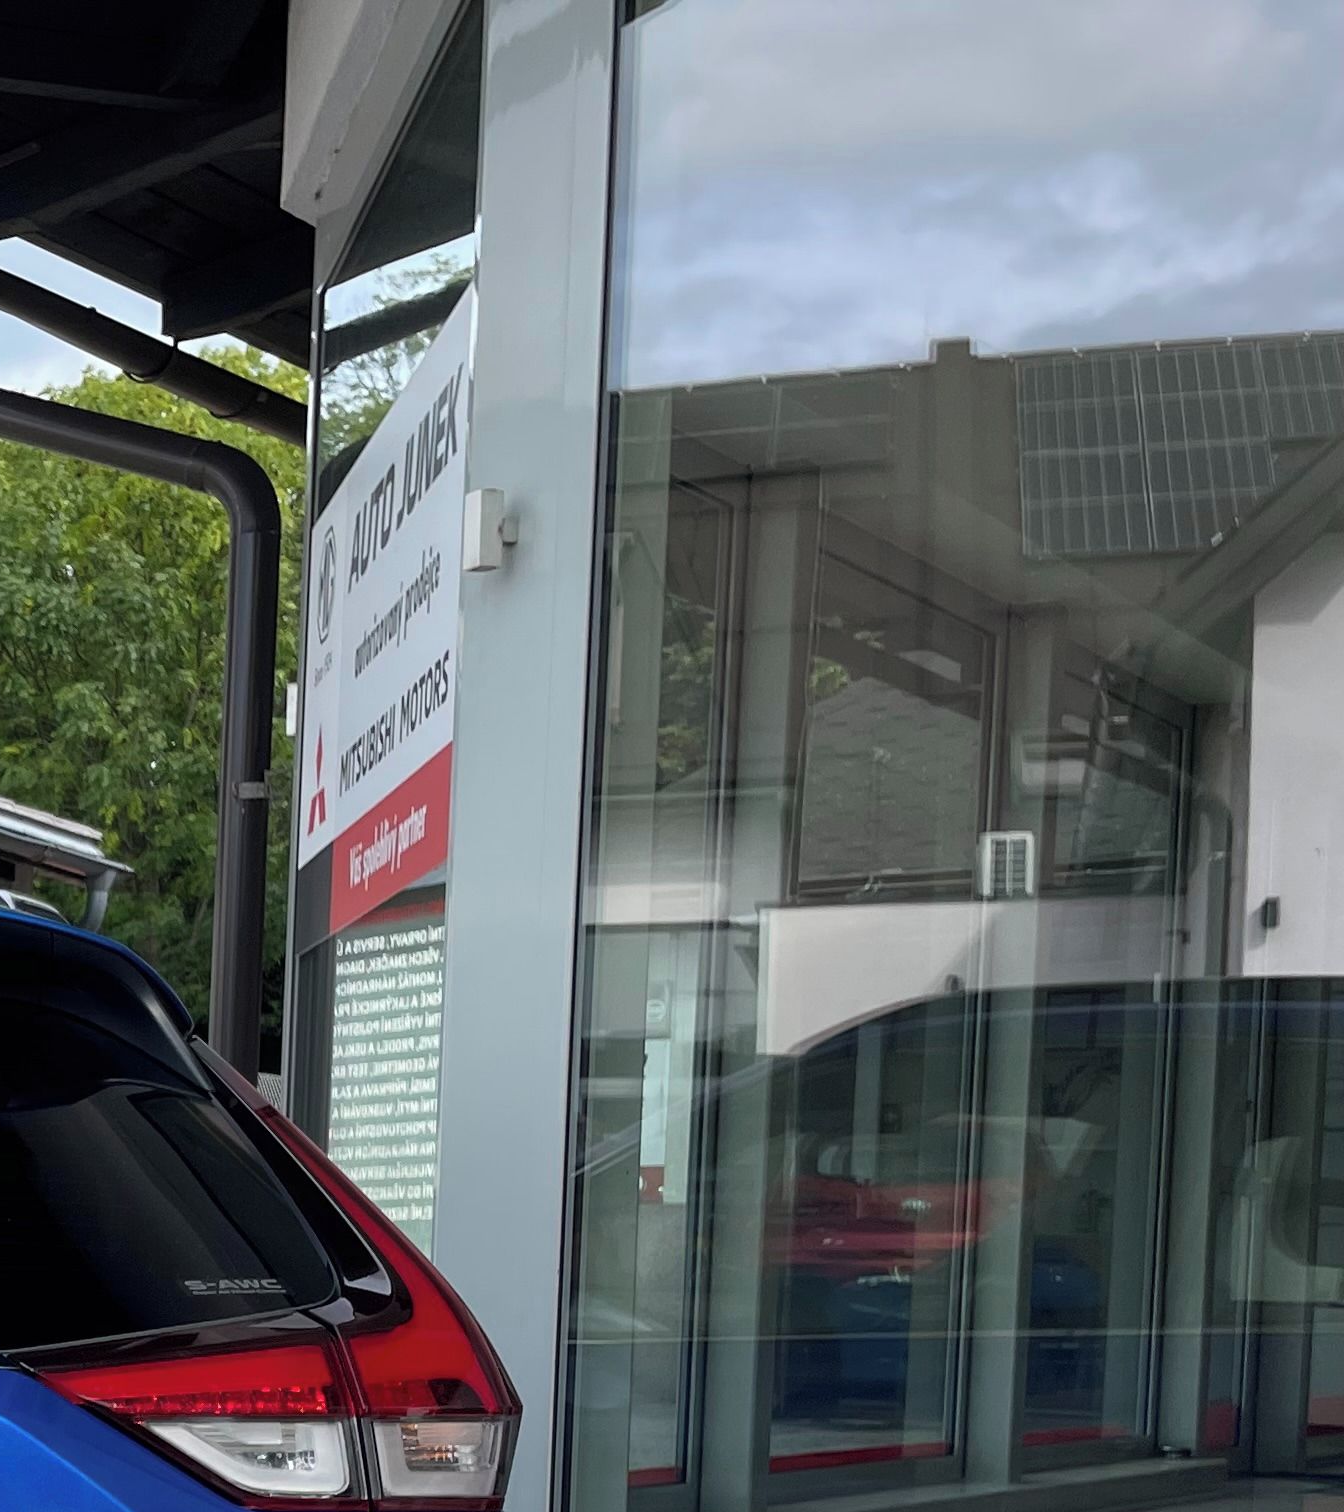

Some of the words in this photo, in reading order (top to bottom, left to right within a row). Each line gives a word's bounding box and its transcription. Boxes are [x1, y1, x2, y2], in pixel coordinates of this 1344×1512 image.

[348, 463, 395, 593] AUTO
[396, 362, 464, 531] JUNEK
[339, 703, 396, 797] MITSUBISHI
[399, 649, 449, 743] MOTORS
[184, 1279, 282, 1291] S-AWC
